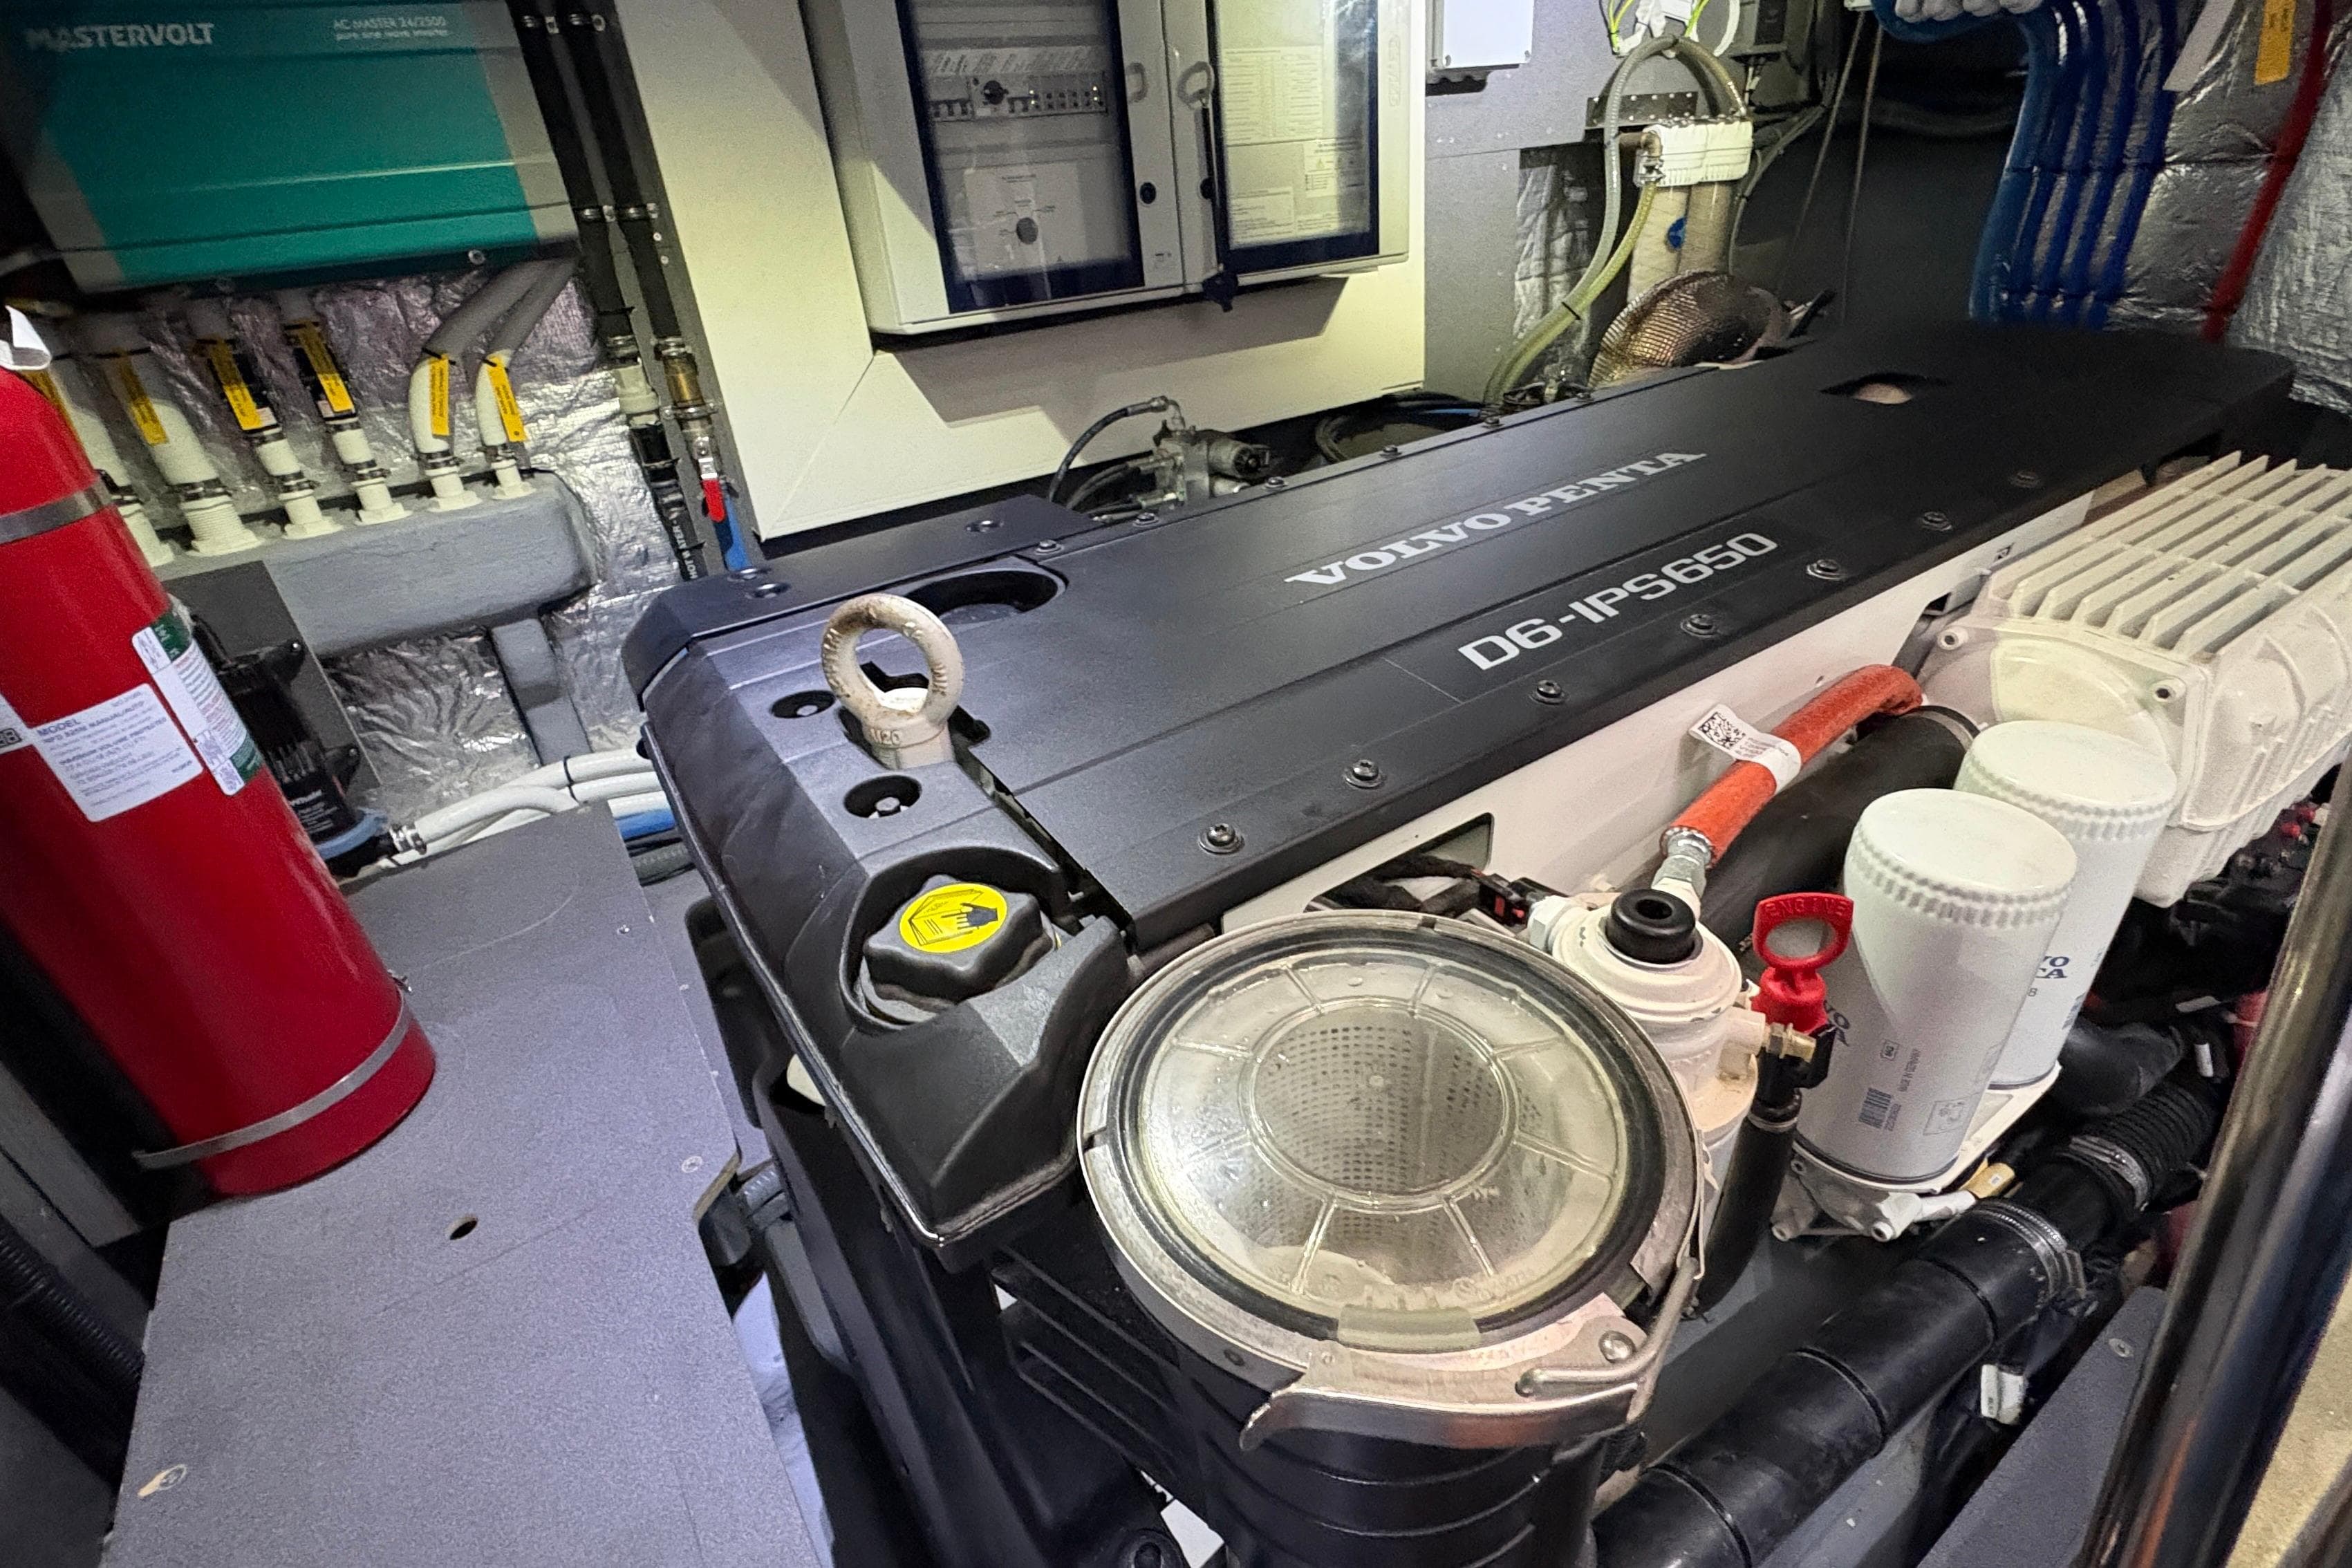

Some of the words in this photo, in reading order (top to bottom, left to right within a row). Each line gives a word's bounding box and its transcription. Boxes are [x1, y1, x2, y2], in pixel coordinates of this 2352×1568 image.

[24, 23, 214, 53] MASTERVOLT
[1285, 512, 1512, 586] VOLVO
[1504, 452, 1708, 516] PENTA
[1458, 533, 1778, 671] D6-IPS650
[37, 718, 81, 737] MODEL
[1765, 897, 1848, 917] ENGINE
